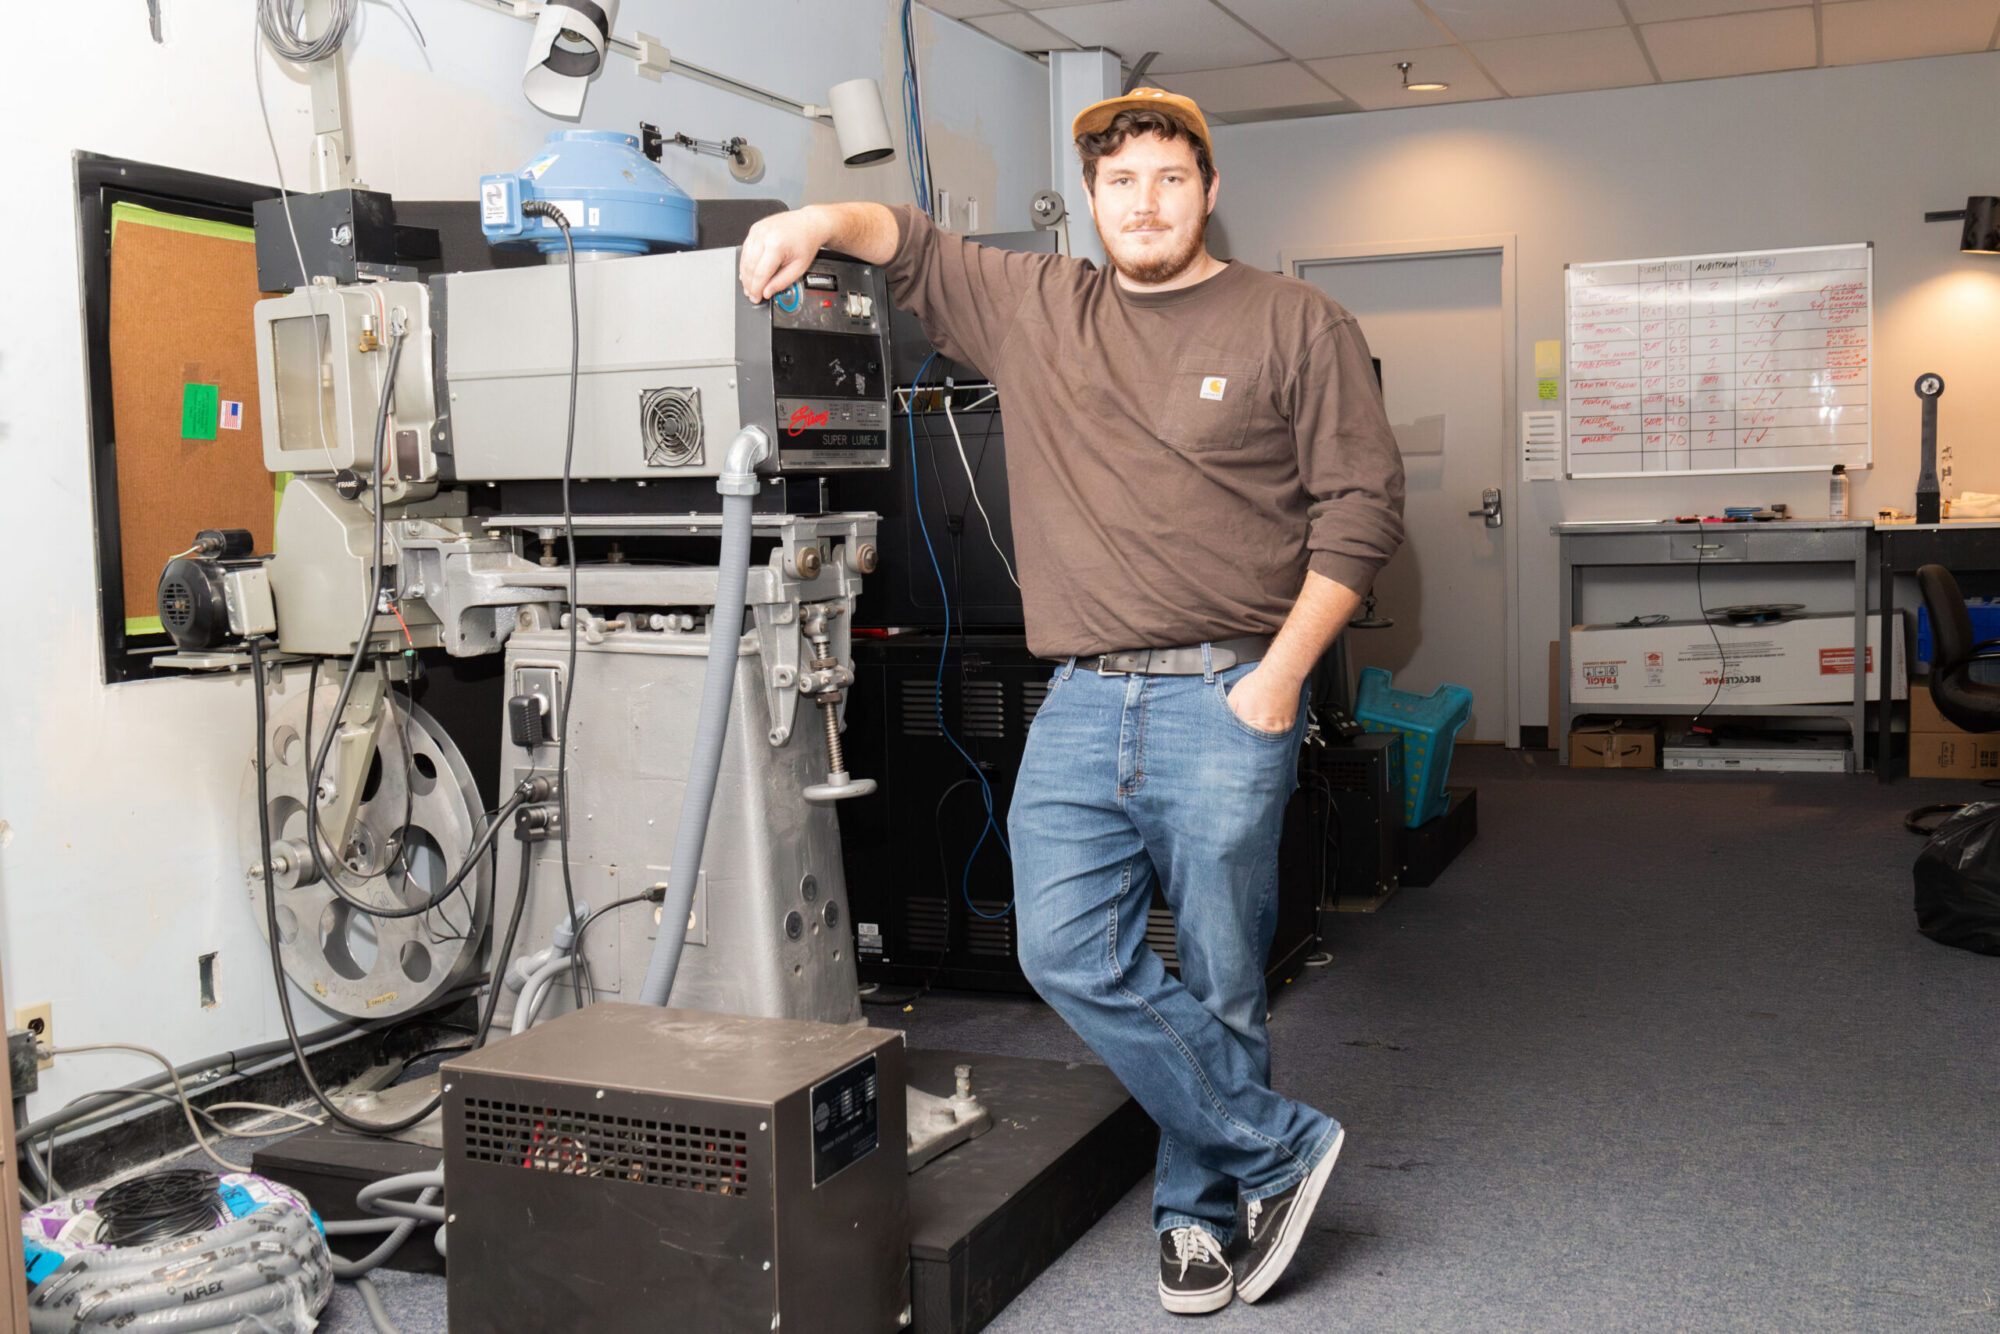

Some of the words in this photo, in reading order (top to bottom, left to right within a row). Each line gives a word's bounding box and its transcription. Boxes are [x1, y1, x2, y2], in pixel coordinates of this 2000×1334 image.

[1668, 339, 1688, 353] 65
[1709, 337, 1720, 349] 2
[1666, 415, 1688, 428] 40
[1708, 415, 1720, 425] 2
[822, 434, 848, 446] SUPER
[851, 434, 879, 446] LUME-X
[1668, 433, 1688, 447] 70
[337, 480, 358, 489] FRAME
[1586, 676, 1617, 687] FRÁGIL
[183, 1280, 225, 1303] ALFLEX
